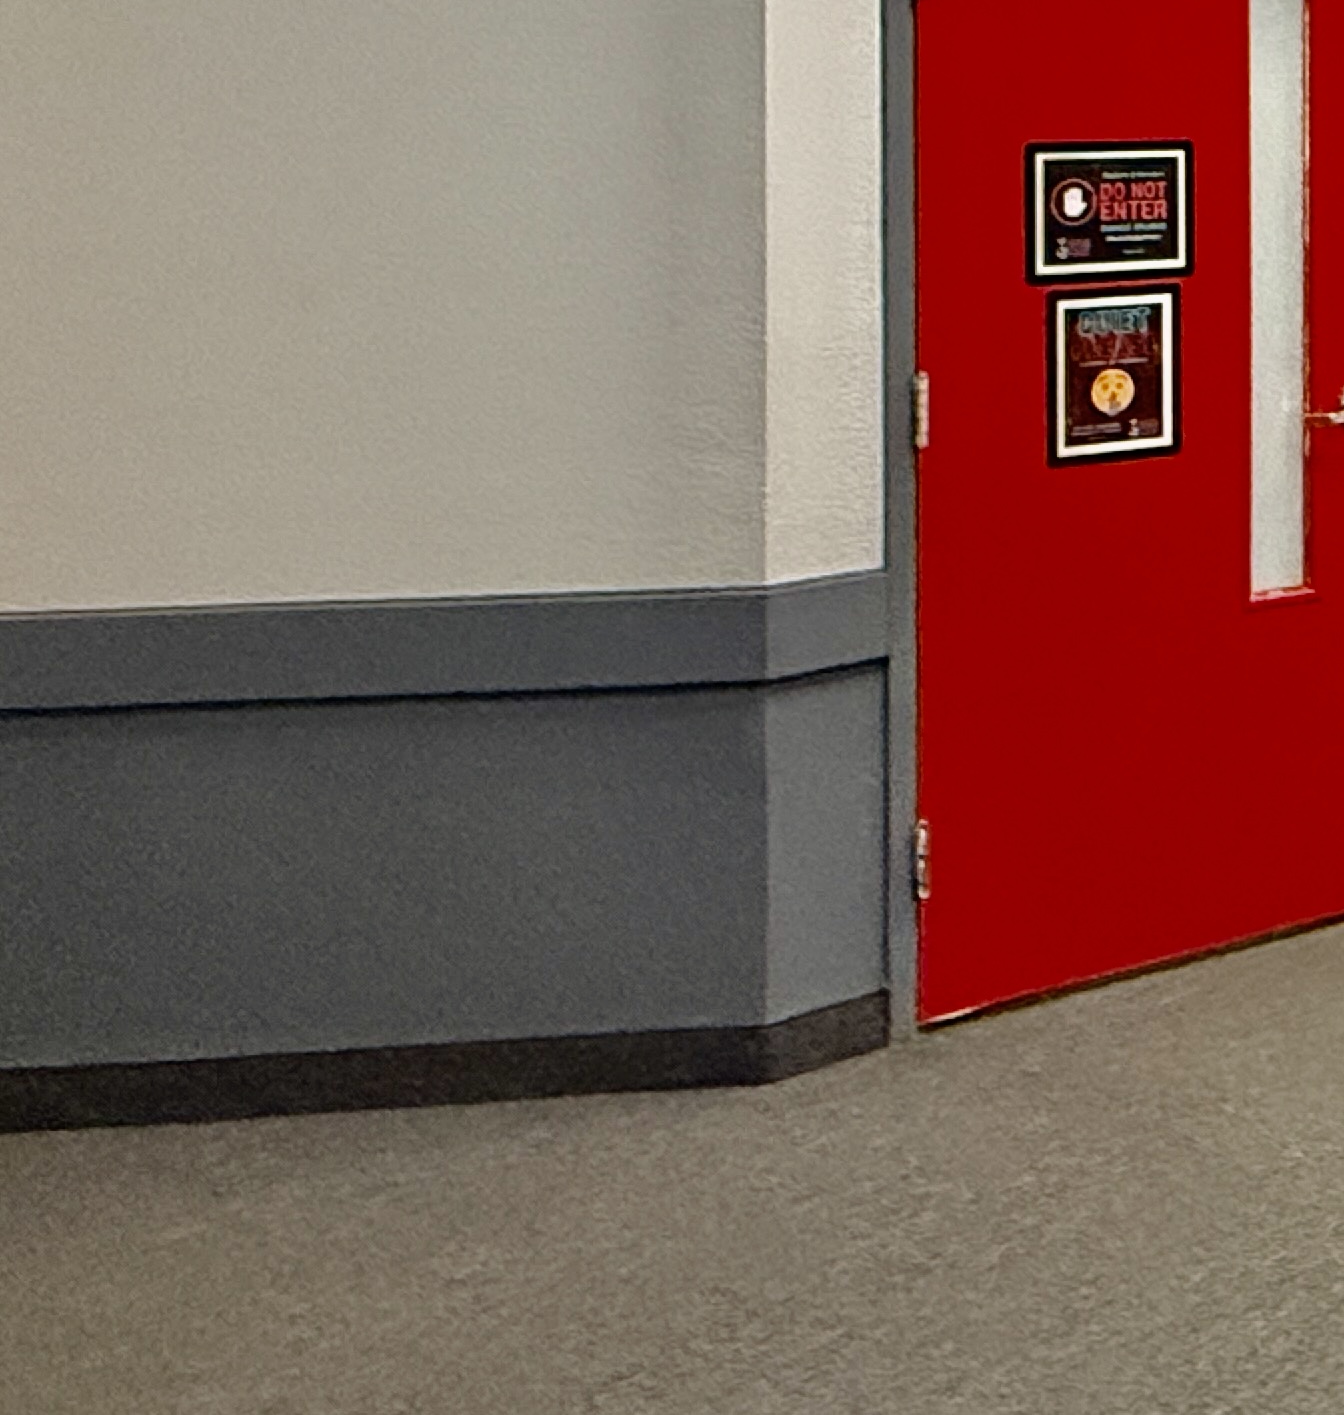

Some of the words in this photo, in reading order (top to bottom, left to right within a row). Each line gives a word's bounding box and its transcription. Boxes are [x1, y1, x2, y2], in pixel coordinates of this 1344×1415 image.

[1100, 182, 1126, 201] DO
[1131, 181, 1167, 198] NOT
[1100, 199, 1167, 221] ENTER
